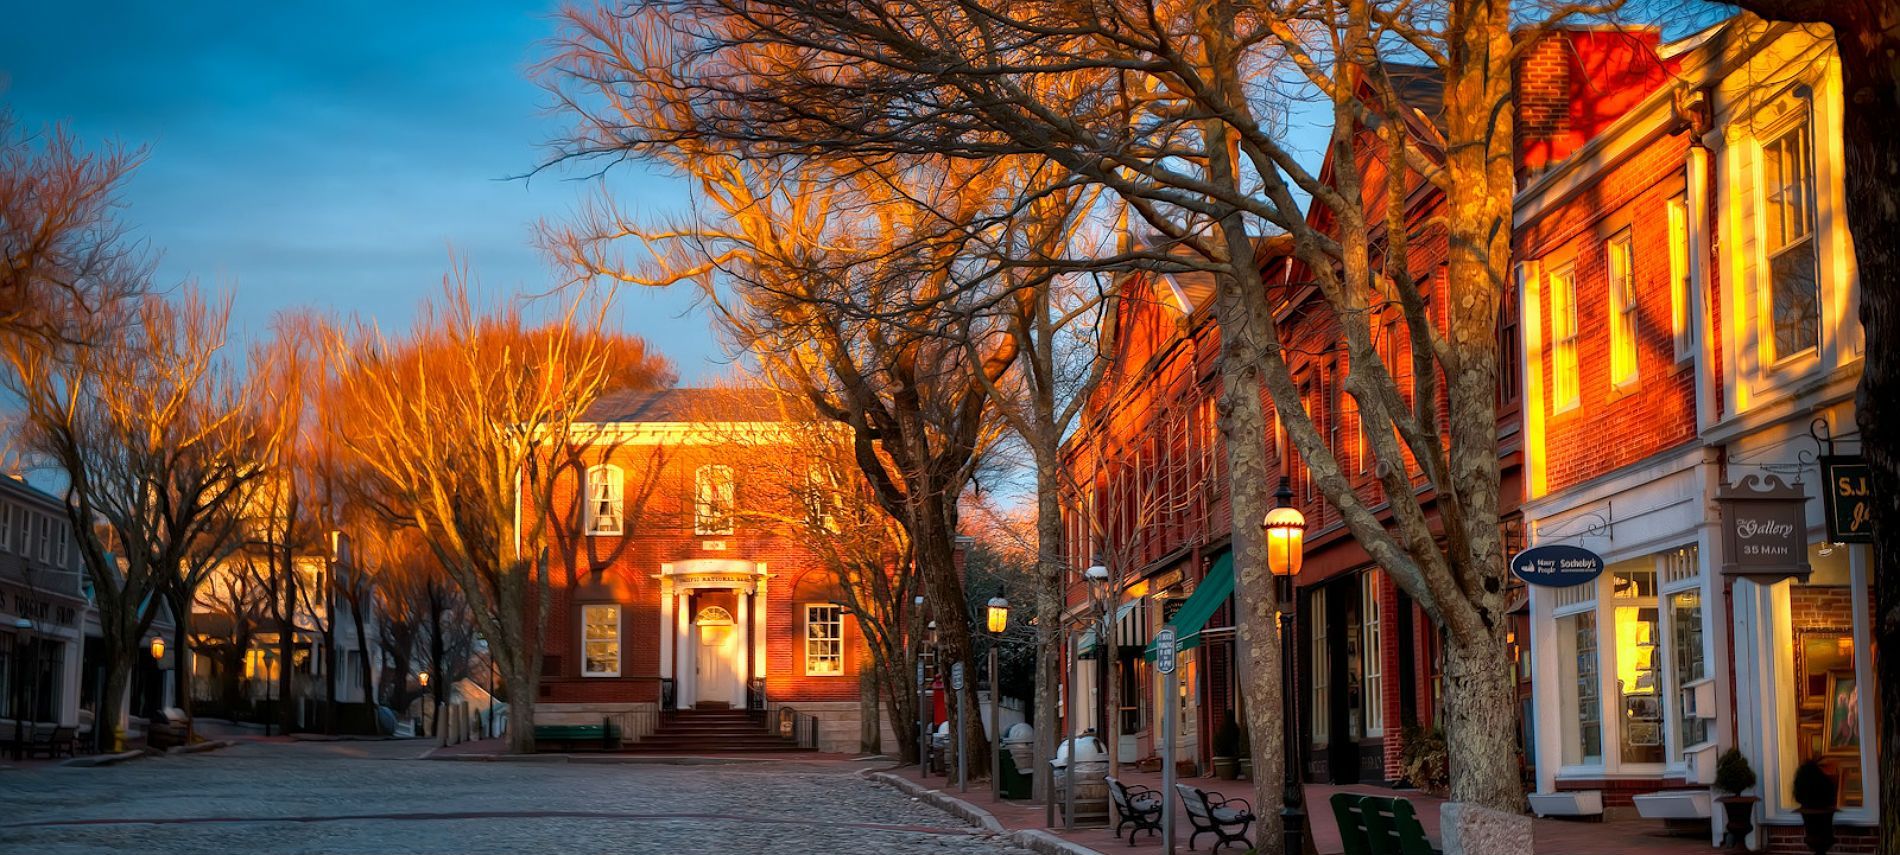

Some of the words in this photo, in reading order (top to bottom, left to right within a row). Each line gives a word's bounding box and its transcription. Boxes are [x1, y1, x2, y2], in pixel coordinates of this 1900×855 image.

[1737, 520, 1793, 539] Gallery
[1744, 545, 1760, 555] 35
[1761, 545, 1788, 555] MAIN
[1560, 558, 1597, 569] Sotheby's
